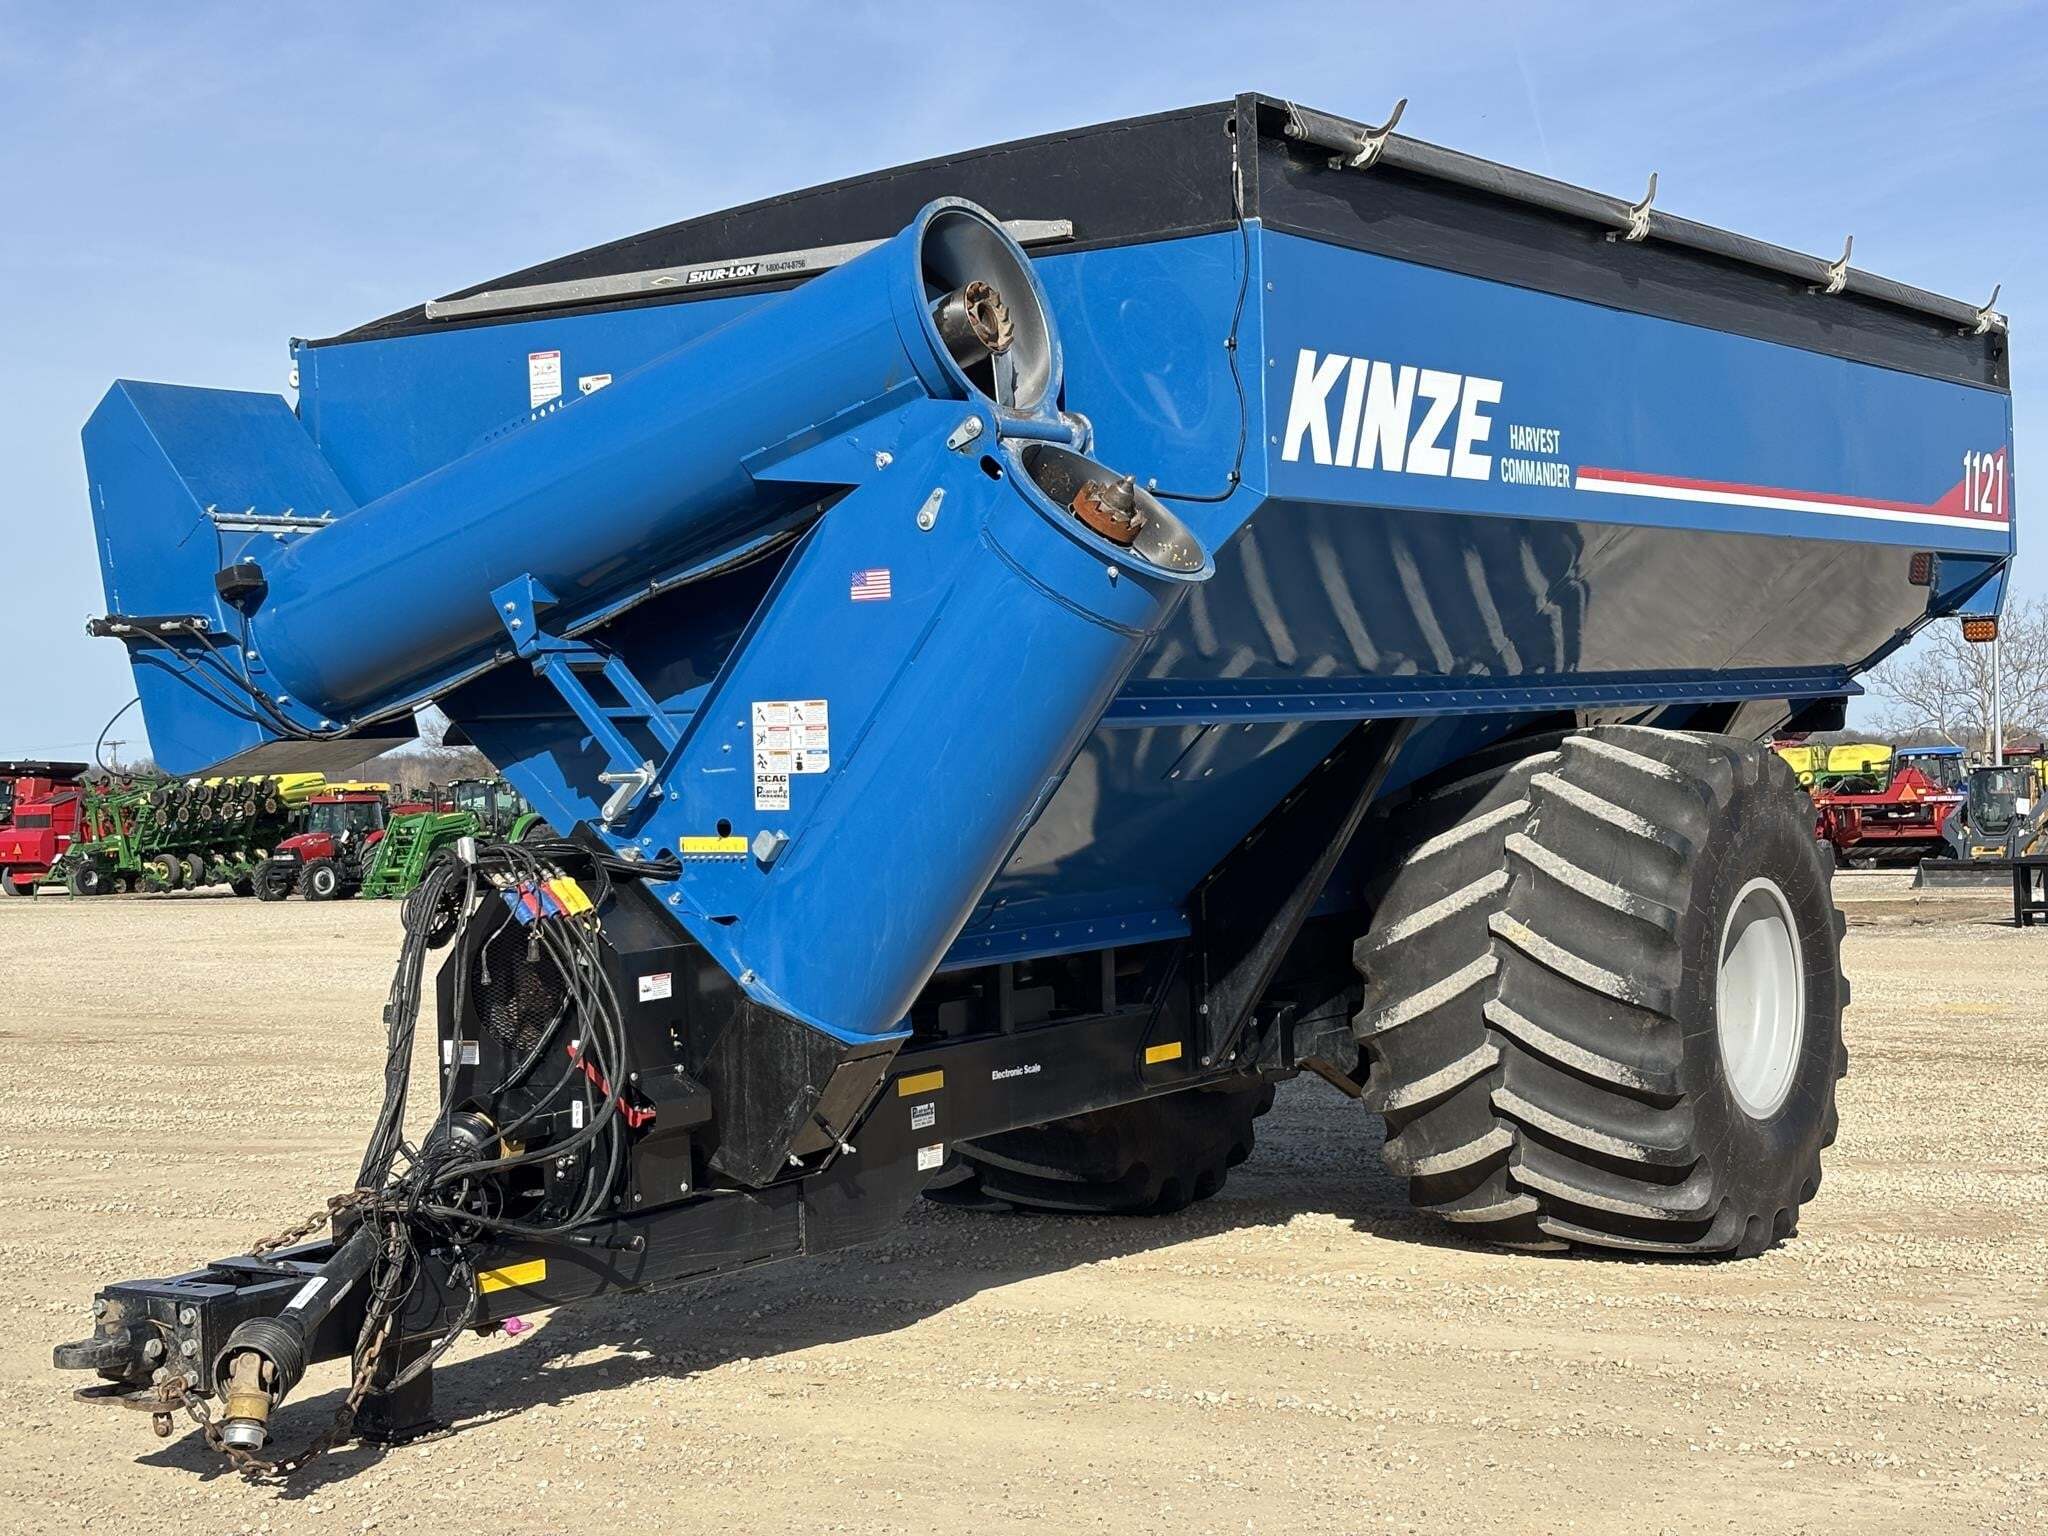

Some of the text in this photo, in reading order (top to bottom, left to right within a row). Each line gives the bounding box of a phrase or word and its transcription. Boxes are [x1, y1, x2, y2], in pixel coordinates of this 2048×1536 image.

[688, 264, 757, 284] SHUR-LOK
[1282, 348, 1504, 481] KINZE
[1509, 424, 1561, 454] HARVEST
[1500, 457, 1570, 488] COMMANDER
[1963, 449, 2004, 515] 1121
[992, 1063, 1041, 1080] Electronic Scale
